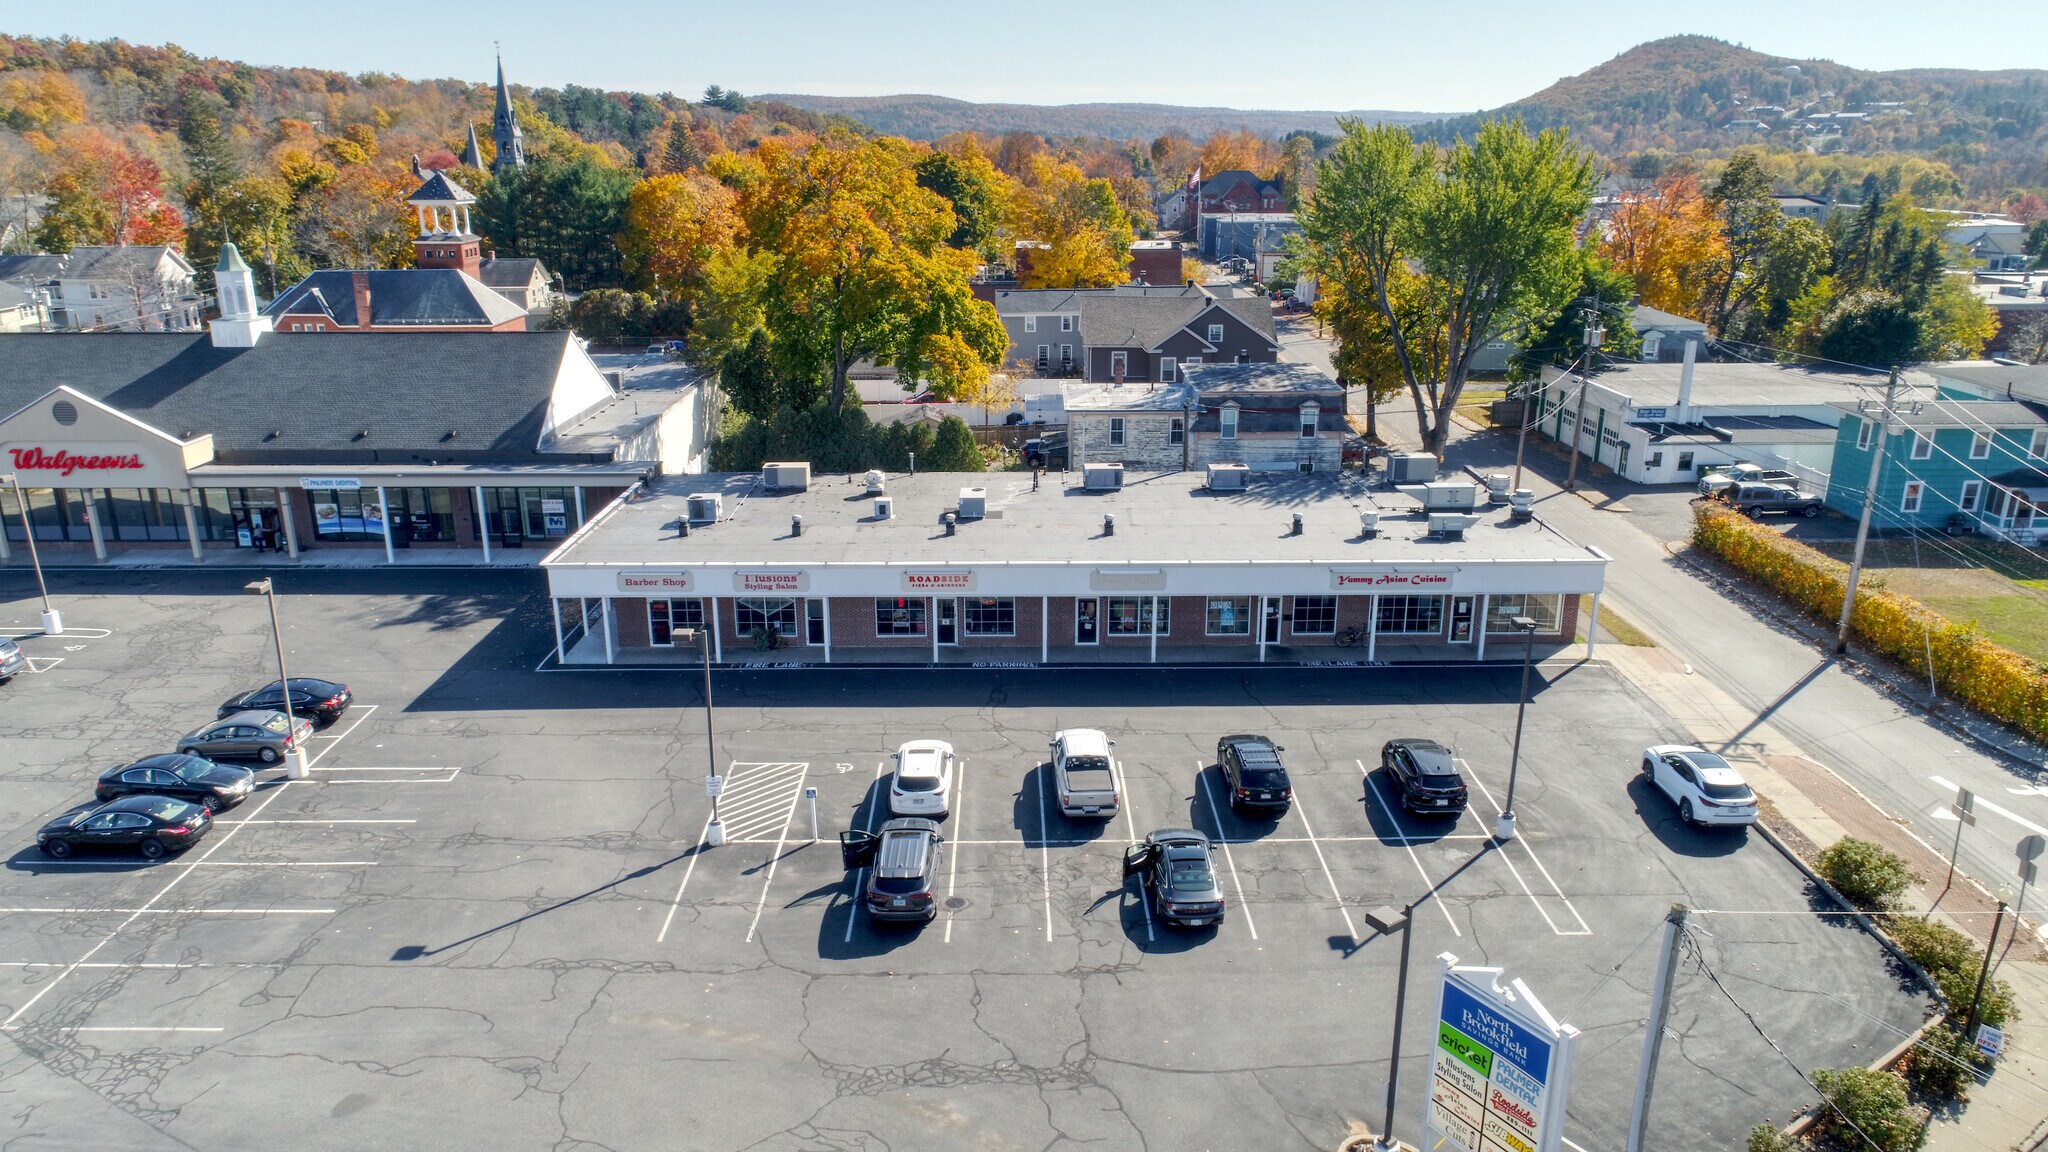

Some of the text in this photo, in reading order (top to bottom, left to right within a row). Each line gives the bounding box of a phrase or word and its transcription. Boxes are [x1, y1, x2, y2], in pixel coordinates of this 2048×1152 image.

[8, 447, 144, 477] Walgreens
[625, 578, 686, 587] Barber Shop
[1338, 575, 1447, 585] Yummy Asian Cuisine
[1462, 1008, 1528, 1060] Brookfield
[1477, 1008, 1514, 1038] North
[1441, 1033, 1488, 1069] cricket
[1461, 1022, 1527, 1066] SAVINGS BANK
[1978, 1038, 1997, 1048] OPEN
[1436, 1062, 1483, 1099] Styling Salon
[1445, 1057, 1476, 1084] Illusions
[1497, 1060, 1540, 1097] PALMER
[1495, 1072, 1537, 1108] DENTAL
[1435, 1105, 1468, 1135] Village
[1492, 1089, 1537, 1128] Roadside
[1445, 1125, 1466, 1147] Cuts
